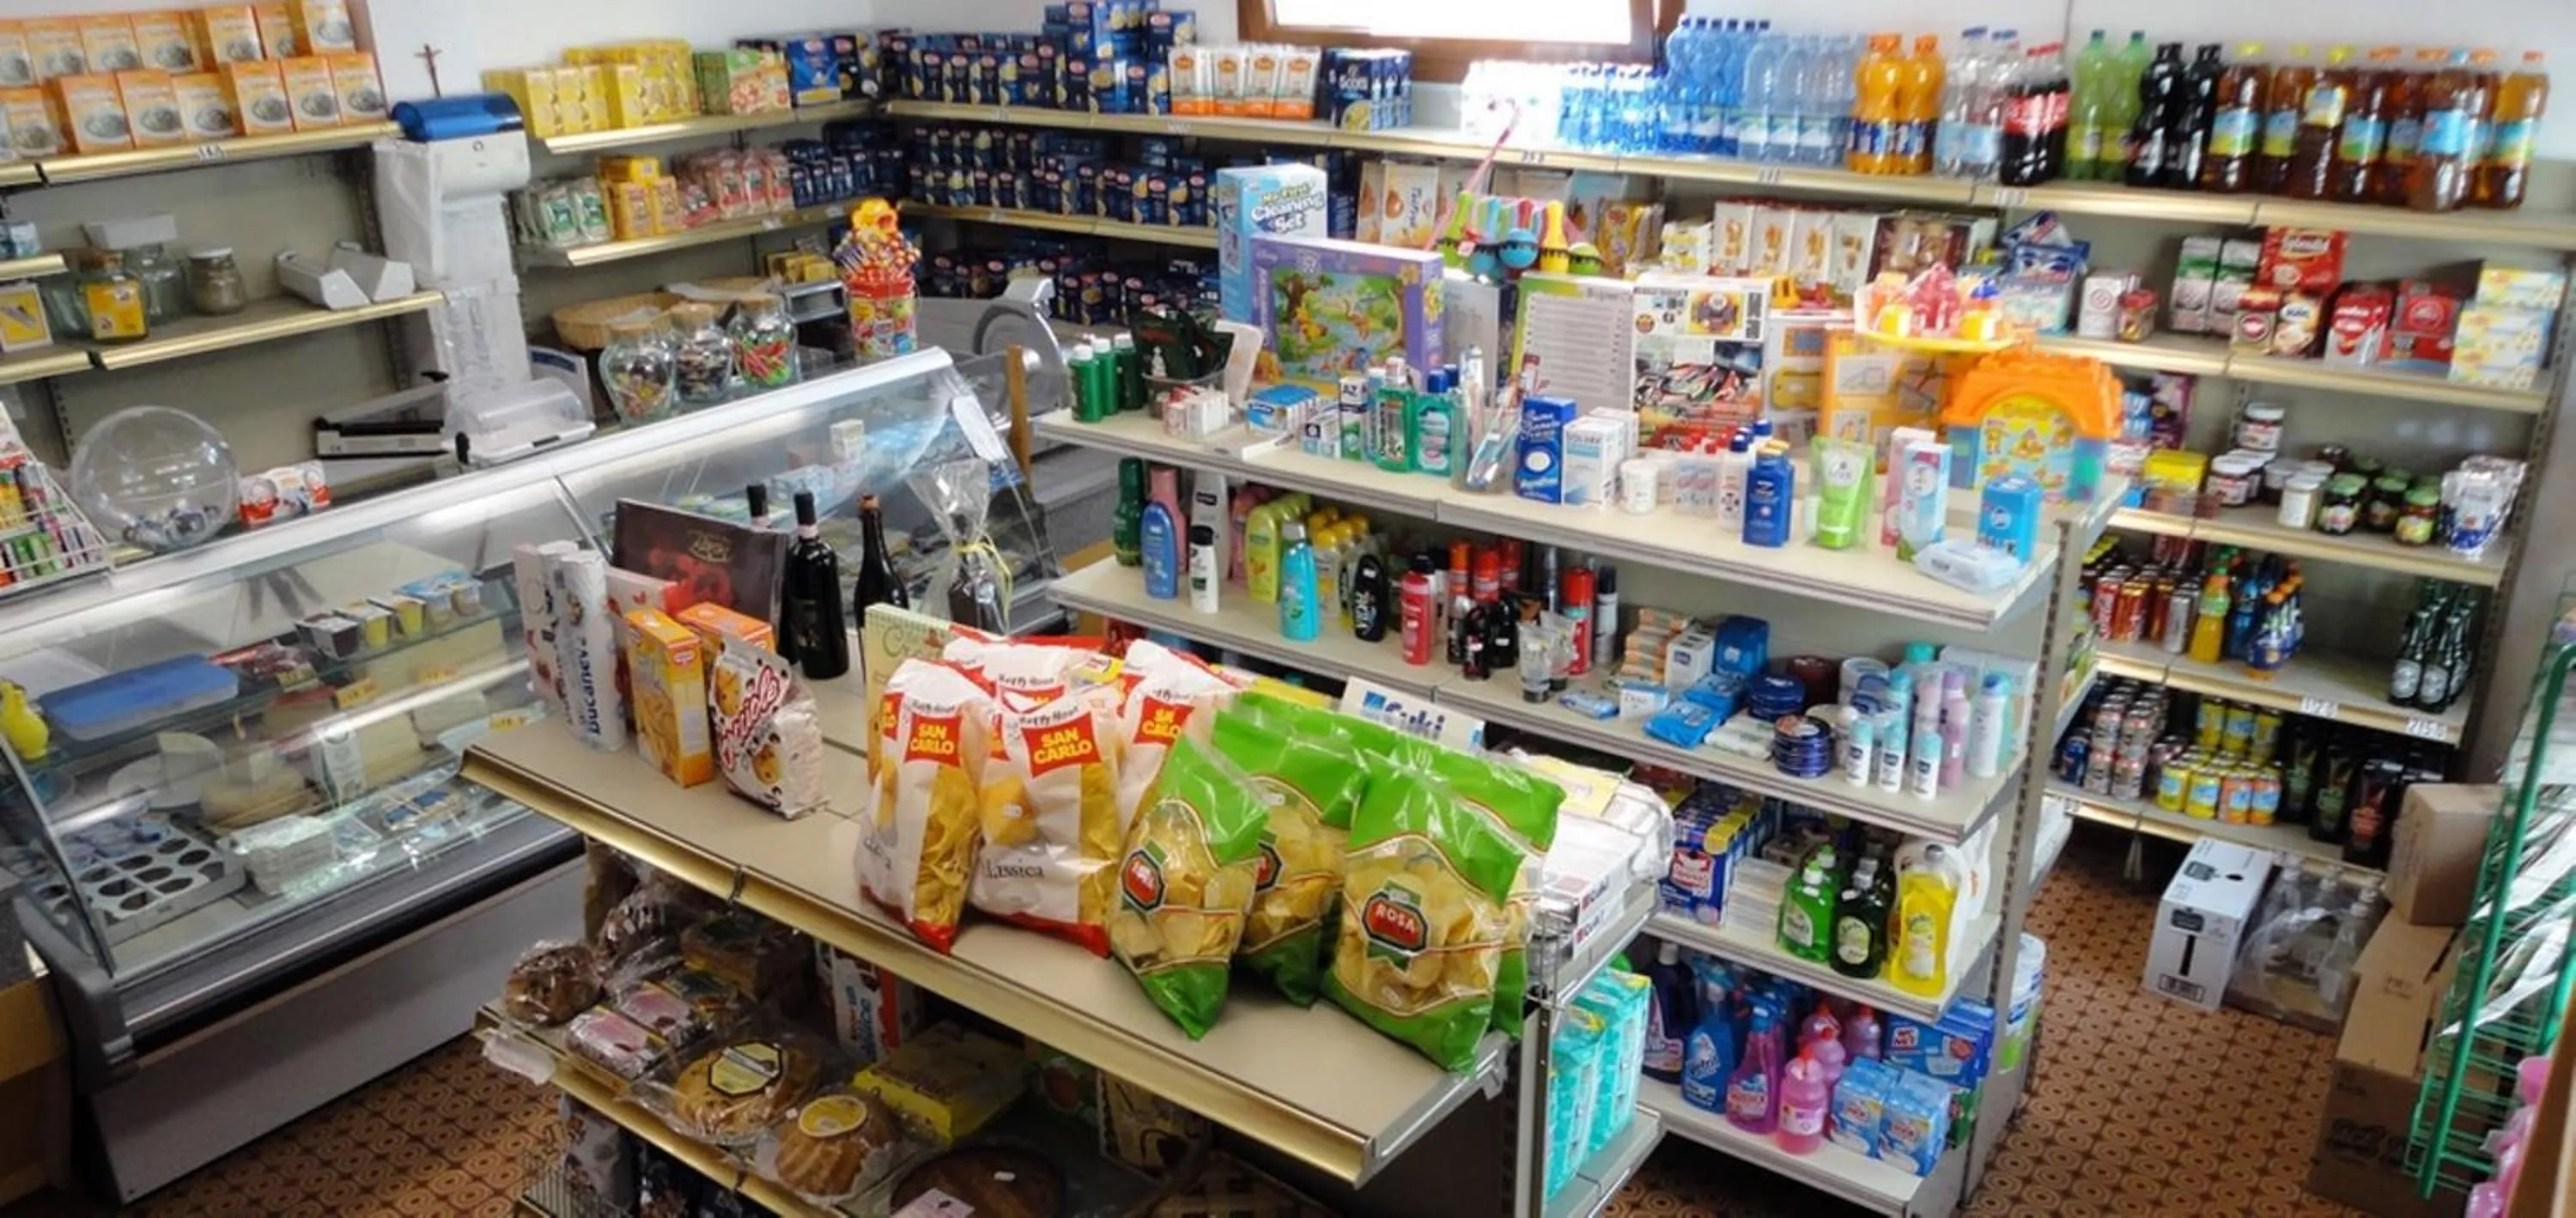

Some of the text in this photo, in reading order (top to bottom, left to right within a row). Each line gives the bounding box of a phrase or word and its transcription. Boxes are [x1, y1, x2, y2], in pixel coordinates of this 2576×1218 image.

[1251, 189, 1325, 222] Cleaning
[918, 723, 948, 739] SAN
[1040, 727, 1080, 748] SAN
[909, 738, 955, 756] CARLO
[1033, 738, 1093, 764] CARLO
[1375, 902, 1416, 935] ROSA
